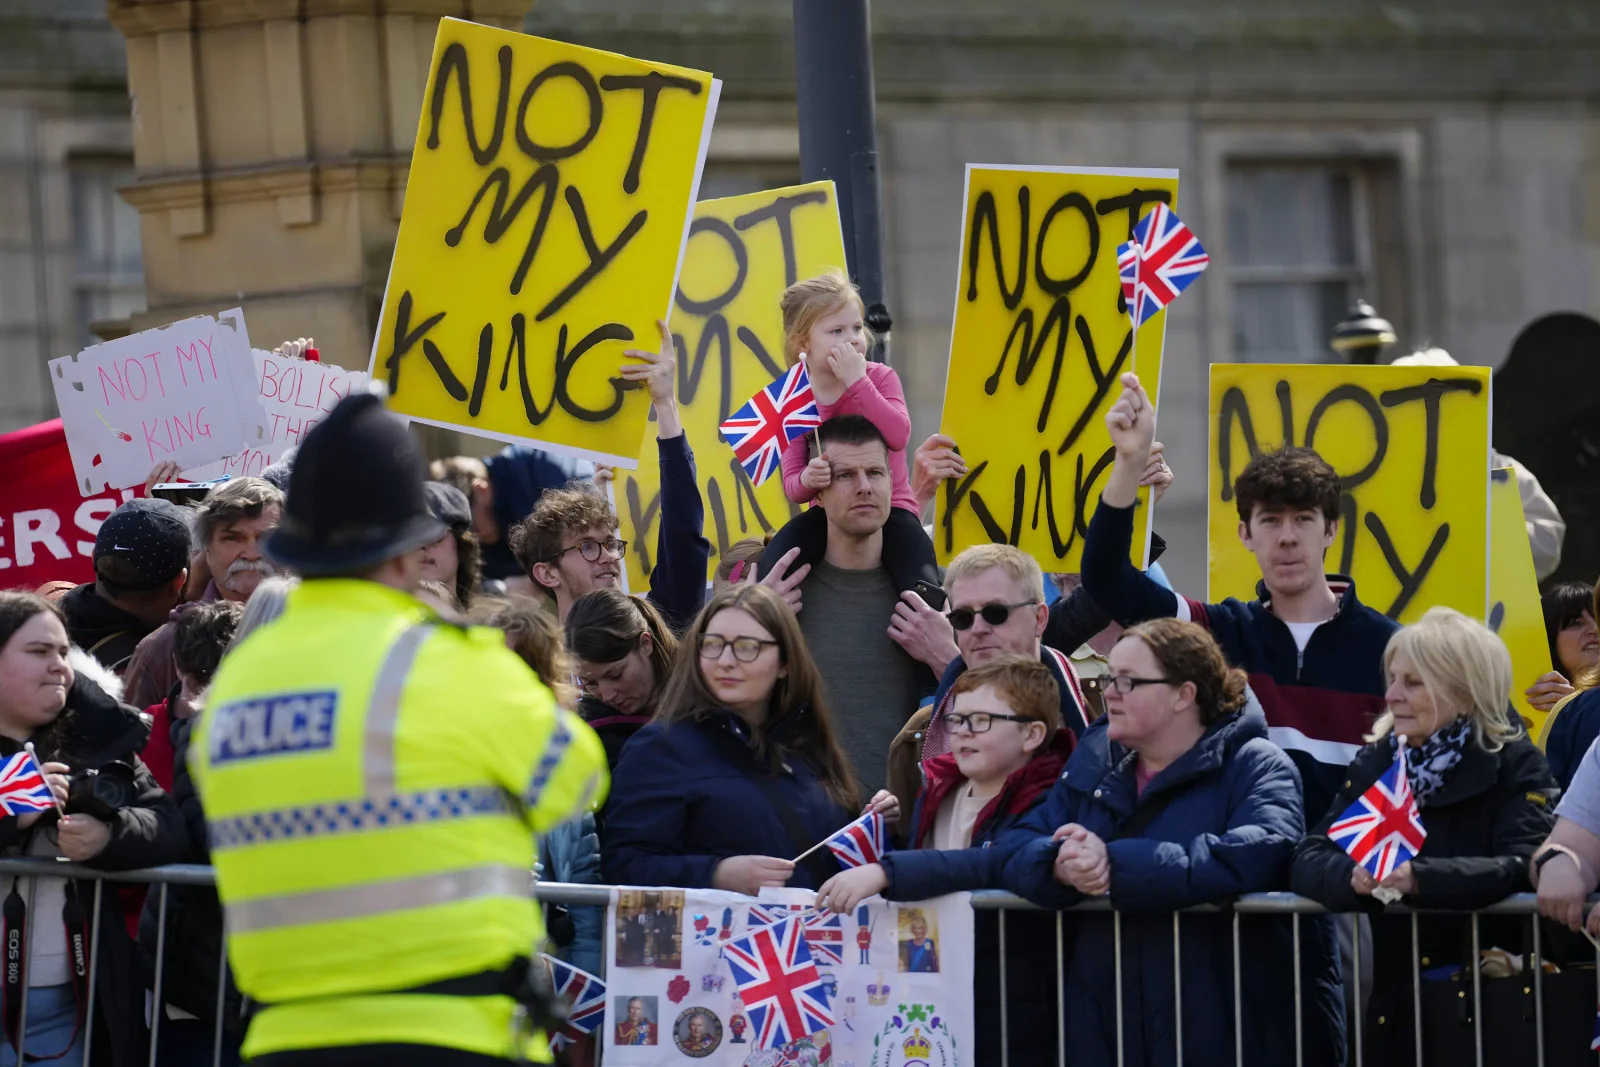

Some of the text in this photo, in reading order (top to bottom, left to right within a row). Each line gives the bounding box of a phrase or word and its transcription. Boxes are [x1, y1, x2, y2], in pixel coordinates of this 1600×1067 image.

[426, 42, 702, 194] NOT
[445, 162, 648, 321] MY
[675, 190, 828, 314] OT
[967, 186, 1171, 313] NOT
[98, 334, 218, 406] NOT MY
[260, 359, 364, 414] BOLIS
[386, 291, 643, 425] KING
[984, 296, 1133, 455] MY
[142, 406, 212, 462] KING
[1219, 378, 1482, 510] NOT
[626, 457, 803, 576] KIN
[211, 697, 332, 758] POLICE
[8, 928, 20, 960] EOS
[72, 933, 87, 977] Canon
